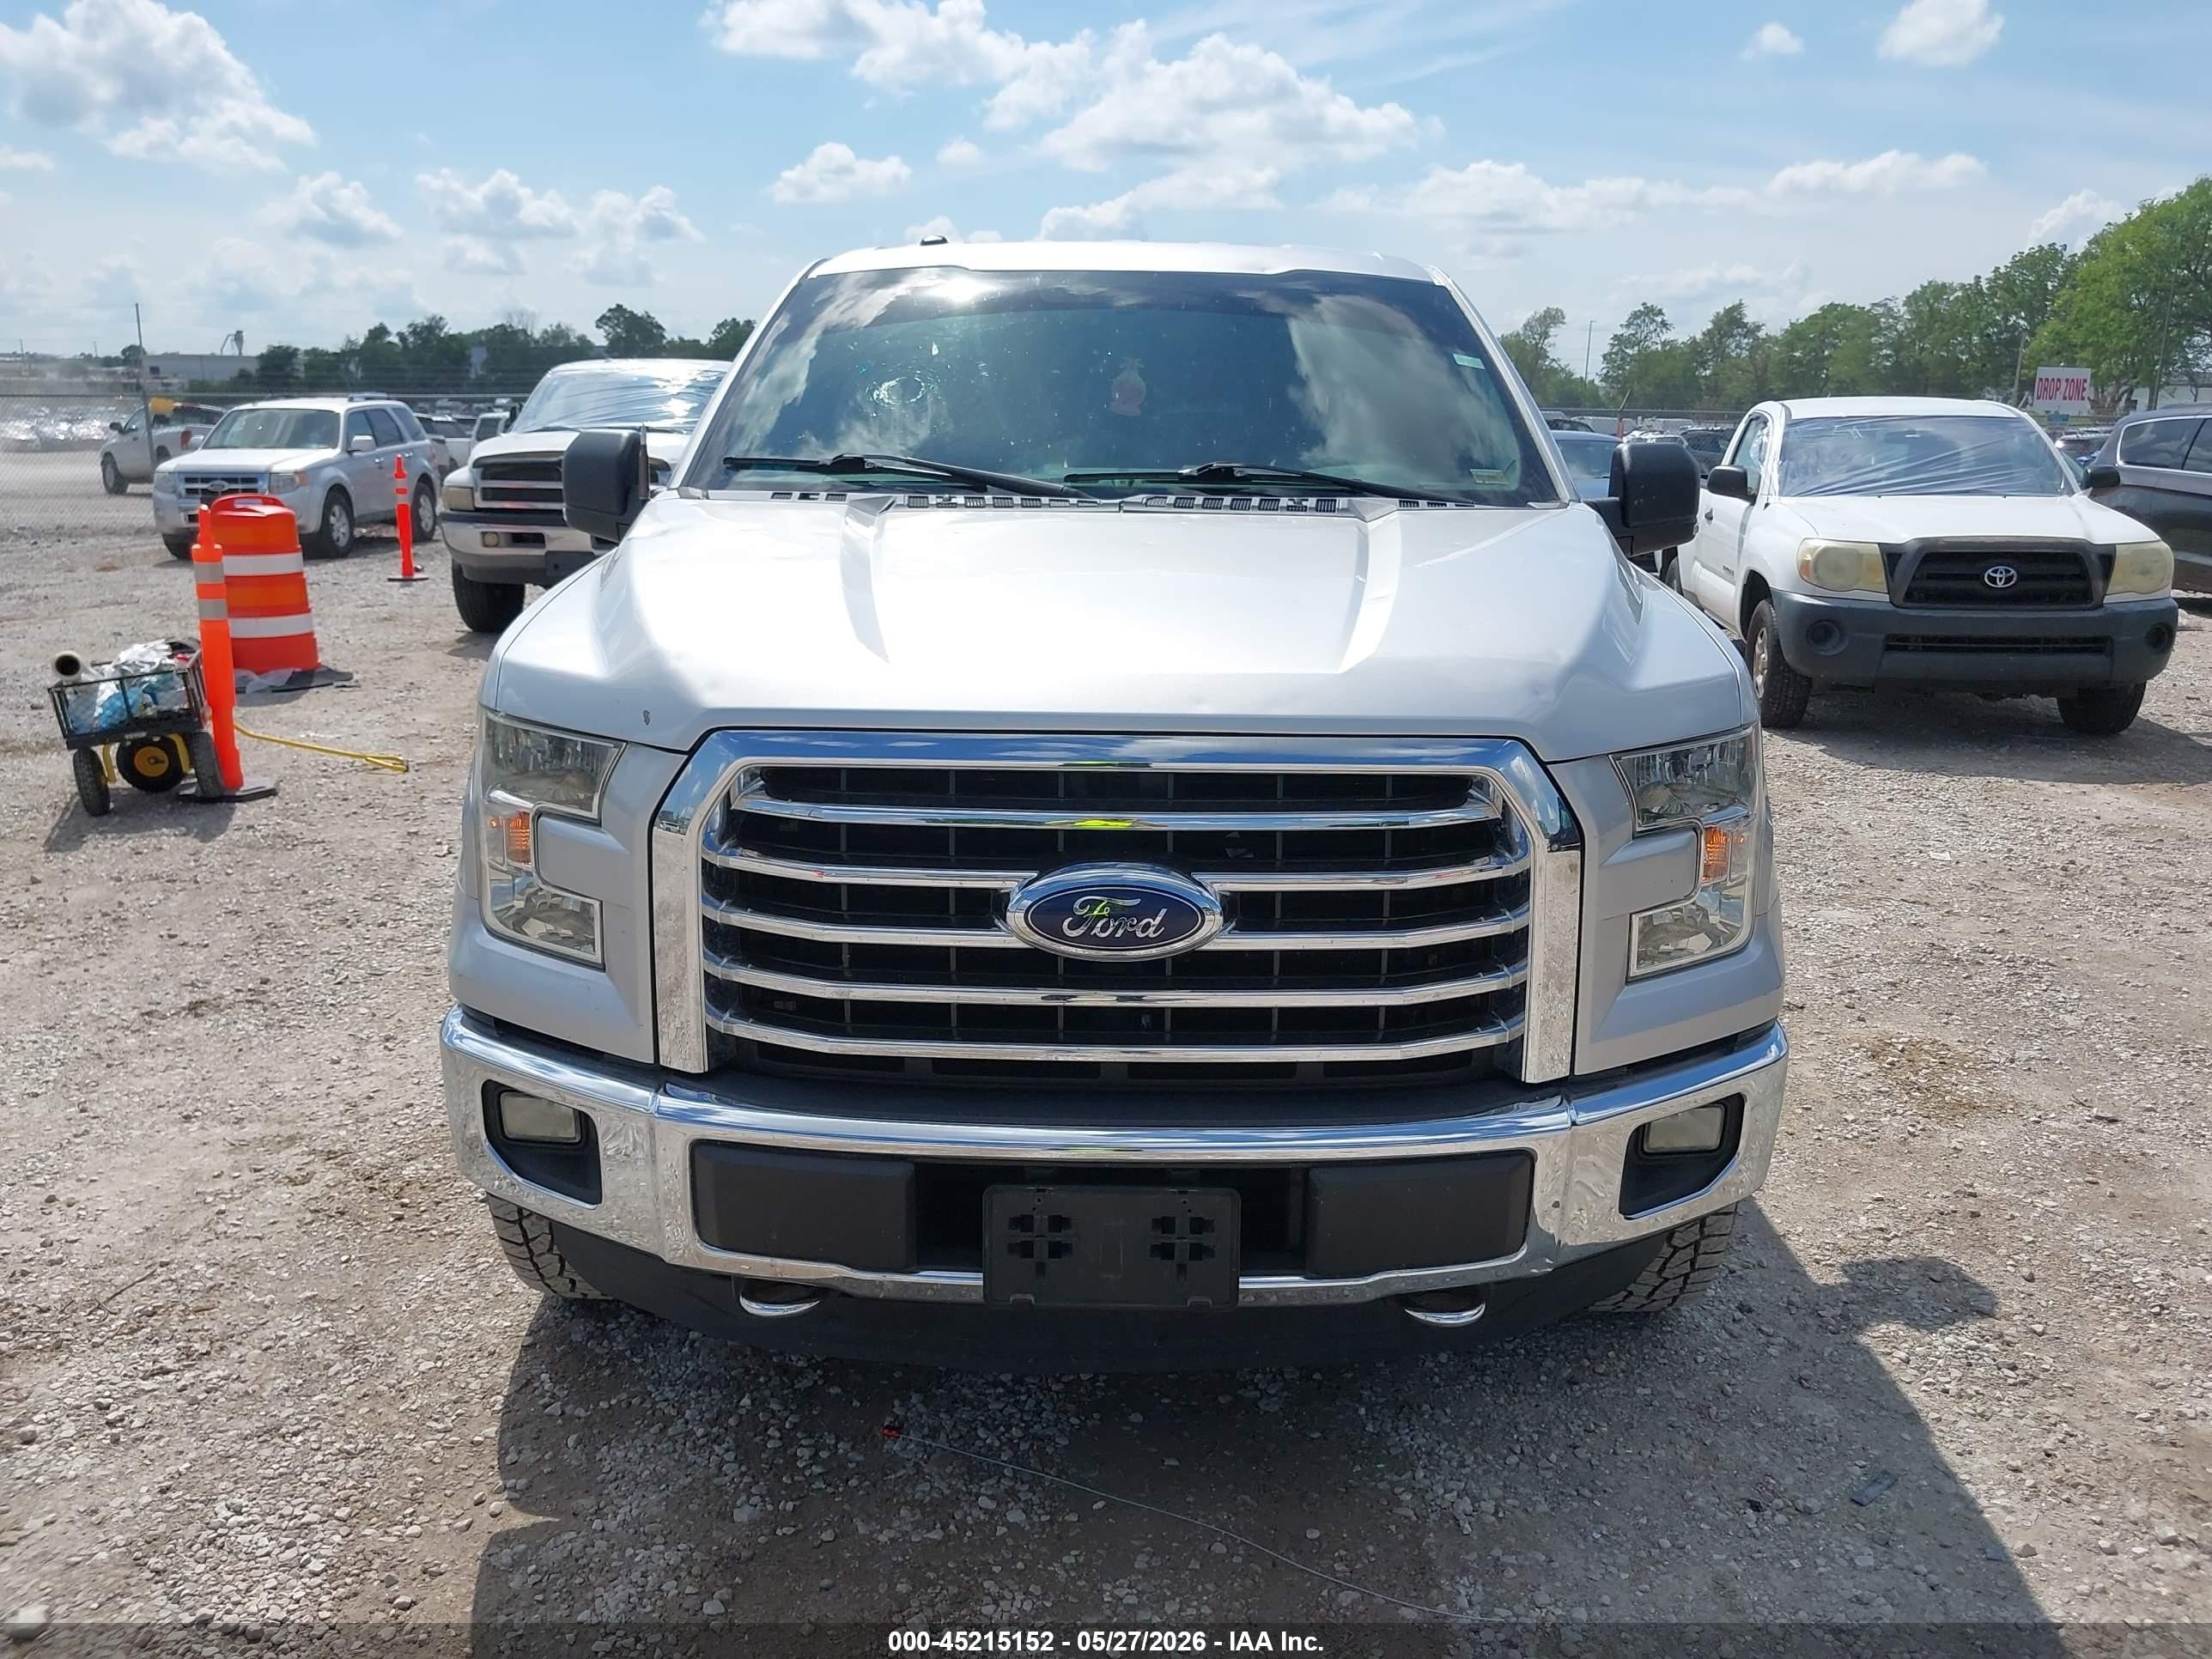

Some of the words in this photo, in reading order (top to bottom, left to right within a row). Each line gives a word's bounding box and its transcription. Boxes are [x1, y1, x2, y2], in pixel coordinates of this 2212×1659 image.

[2036, 378, 2061, 400] DROP
[2062, 378, 2087, 401] ZONE
[1061, 896, 1168, 939] Ford
